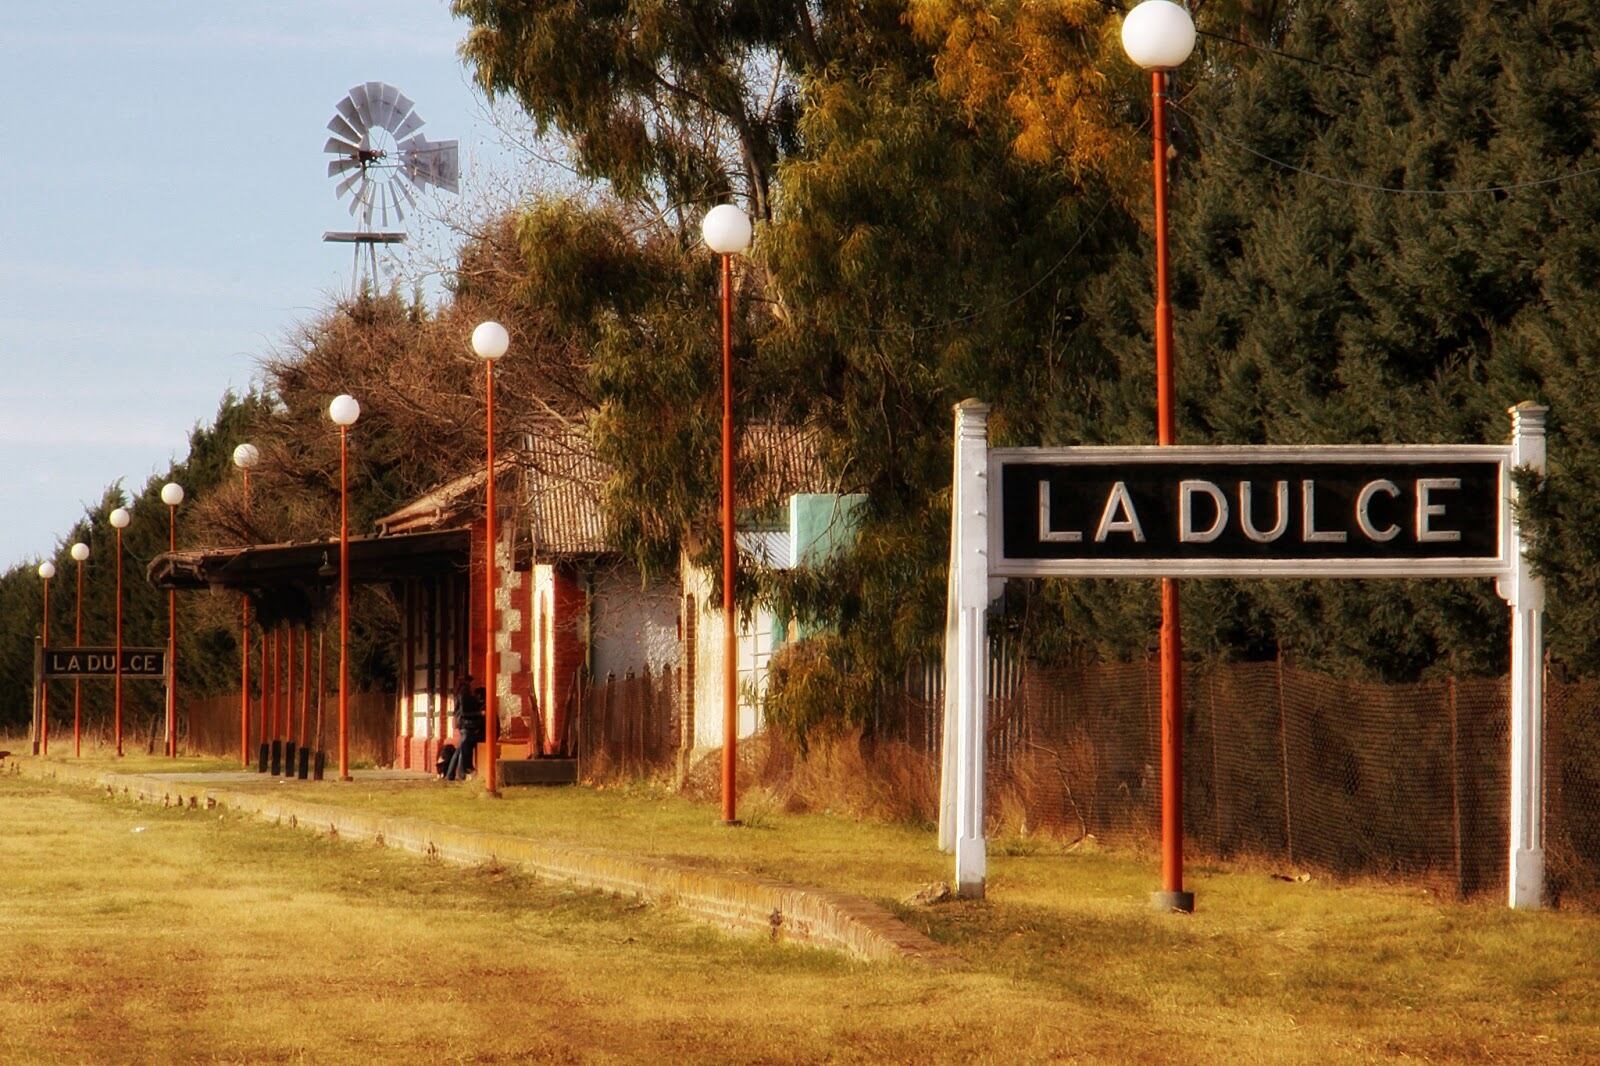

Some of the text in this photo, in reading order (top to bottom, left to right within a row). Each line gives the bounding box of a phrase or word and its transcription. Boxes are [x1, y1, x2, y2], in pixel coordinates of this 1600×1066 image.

[1039, 477, 1461, 542] LA DULCE
[53, 655, 80, 671] LA
